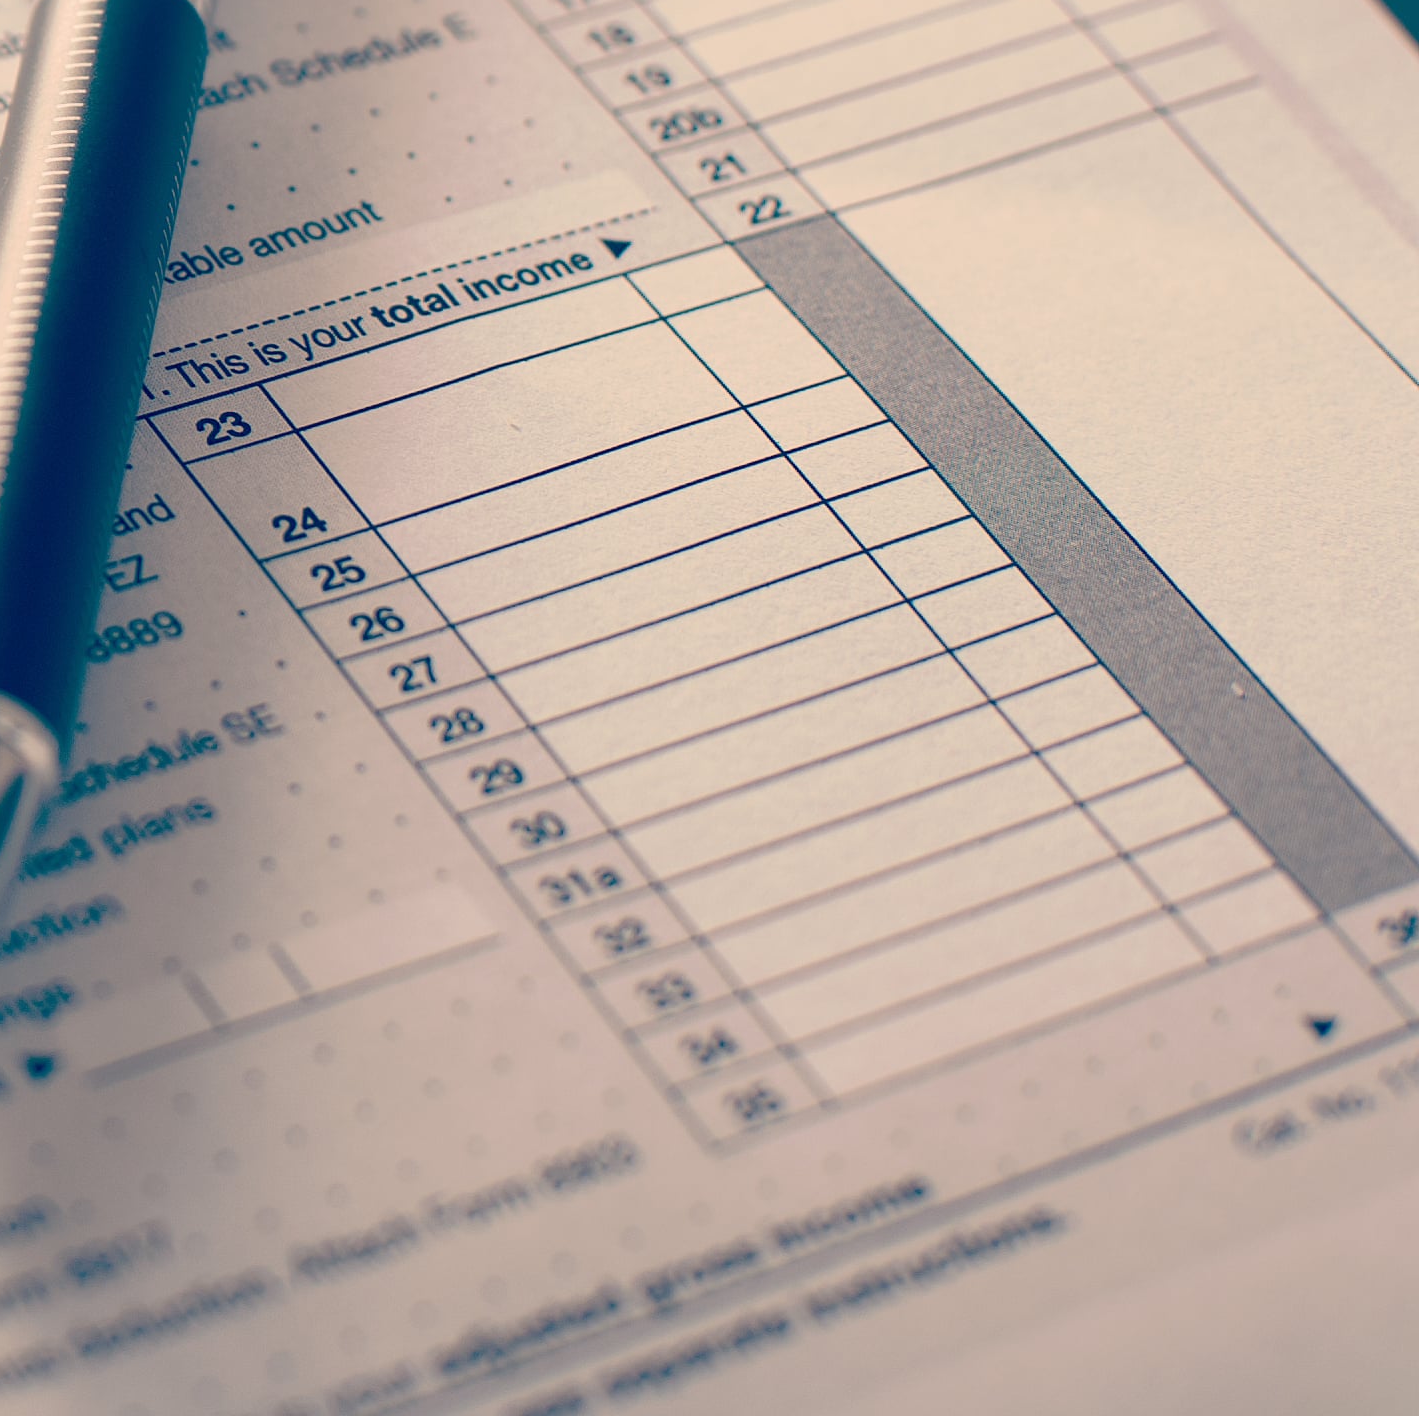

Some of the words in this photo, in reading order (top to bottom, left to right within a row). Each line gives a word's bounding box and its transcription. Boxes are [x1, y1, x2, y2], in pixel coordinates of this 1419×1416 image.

[268, 28, 443, 88] Schedule
[647, 99, 724, 143] 20b
[696, 150, 749, 184] 21
[247, 199, 383, 258] amount
[736, 192, 792, 227] 22
[163, 351, 250, 388] This
[246, 340, 288, 366] is
[287, 315, 367, 361] your
[368, 282, 461, 328] total
[455, 252, 594, 302] income
[195, 410, 252, 446] 23
[271, 505, 328, 543] 24
[308, 555, 367, 592] 25
[348, 605, 406, 642] 26
[387, 653, 440, 693] 27
[427, 706, 487, 744] 28
[467, 756, 527, 797] 29
[507, 809, 570, 851] 30
[535, 864, 626, 908] 31a
